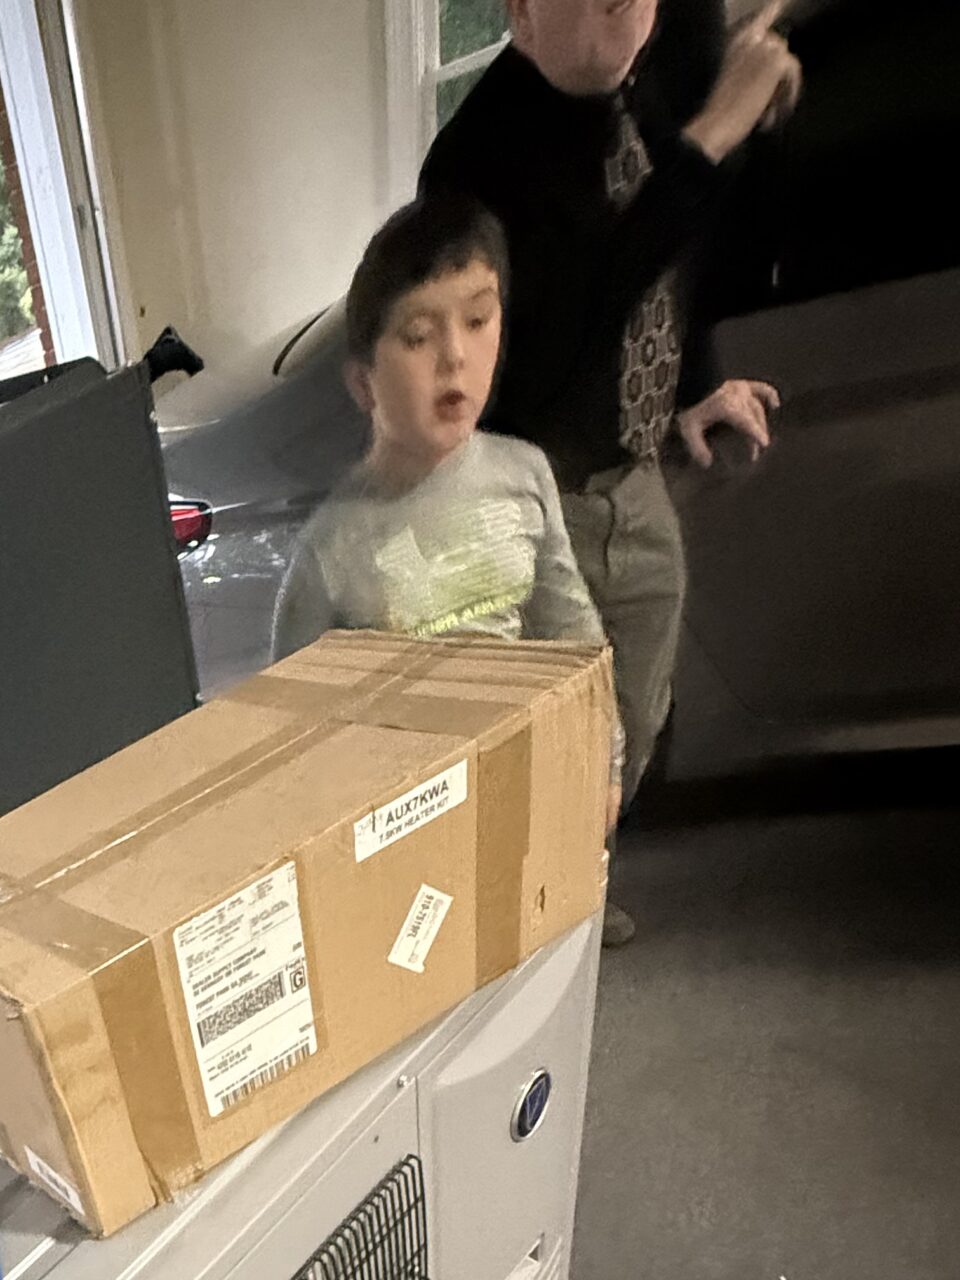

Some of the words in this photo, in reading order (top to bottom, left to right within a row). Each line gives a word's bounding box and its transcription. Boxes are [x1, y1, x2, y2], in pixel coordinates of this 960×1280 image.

[385, 779, 449, 826] AUX7KWA
[404, 804, 436, 828] HEATER
[436, 796, 450, 809] KIT
[293, 971, 304, 988] G
